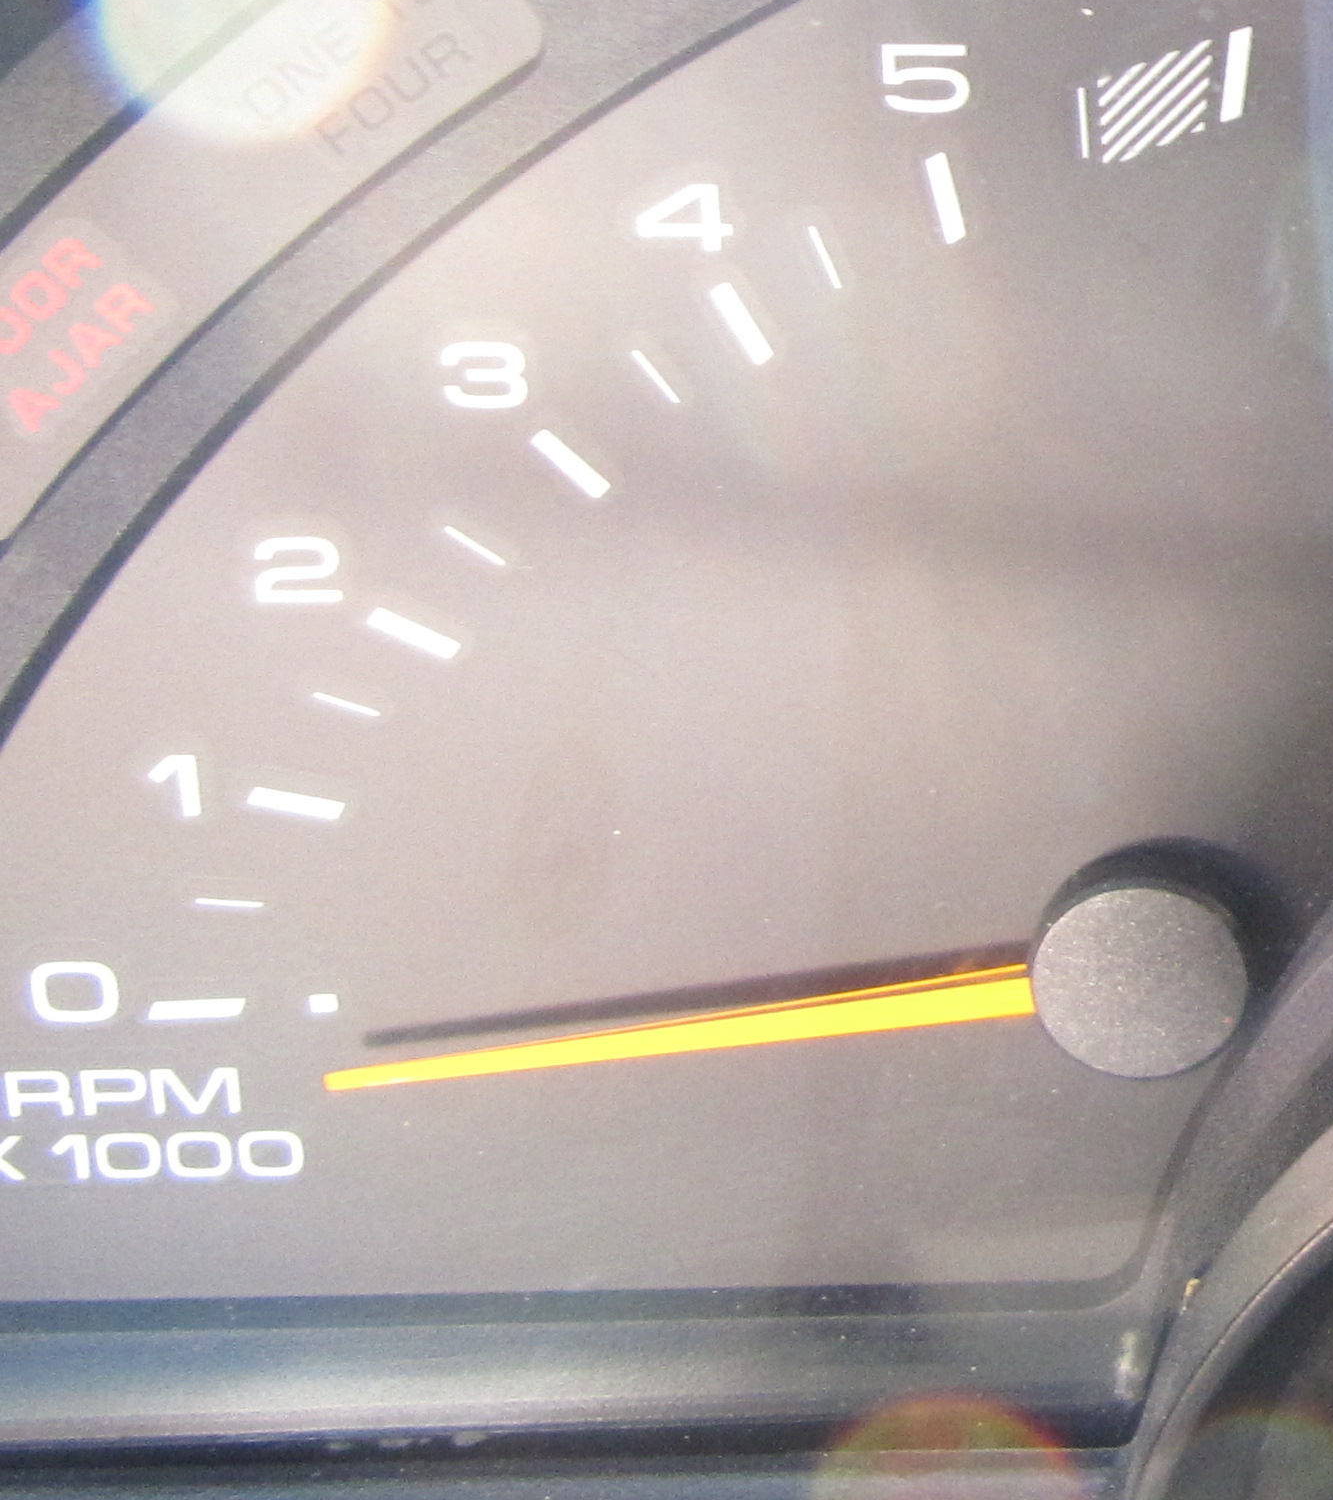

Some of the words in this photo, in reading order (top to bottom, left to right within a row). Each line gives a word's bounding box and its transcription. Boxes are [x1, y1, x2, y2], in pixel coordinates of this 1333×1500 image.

[242, 19, 363, 123] ONE
[313, 30, 473, 157] FOUR
[880, 42, 970, 115] 5
[634, 183, 734, 252] 4
[8, 283, 156, 433] AJAR
[439, 339, 529, 410] 3
[252, 536, 344, 605] 2
[146, 754, 203, 819] 1
[29, 961, 119, 1025] 0
[3, 1066, 242, 1118] RPM
[50, 1130, 305, 1181] 1000
